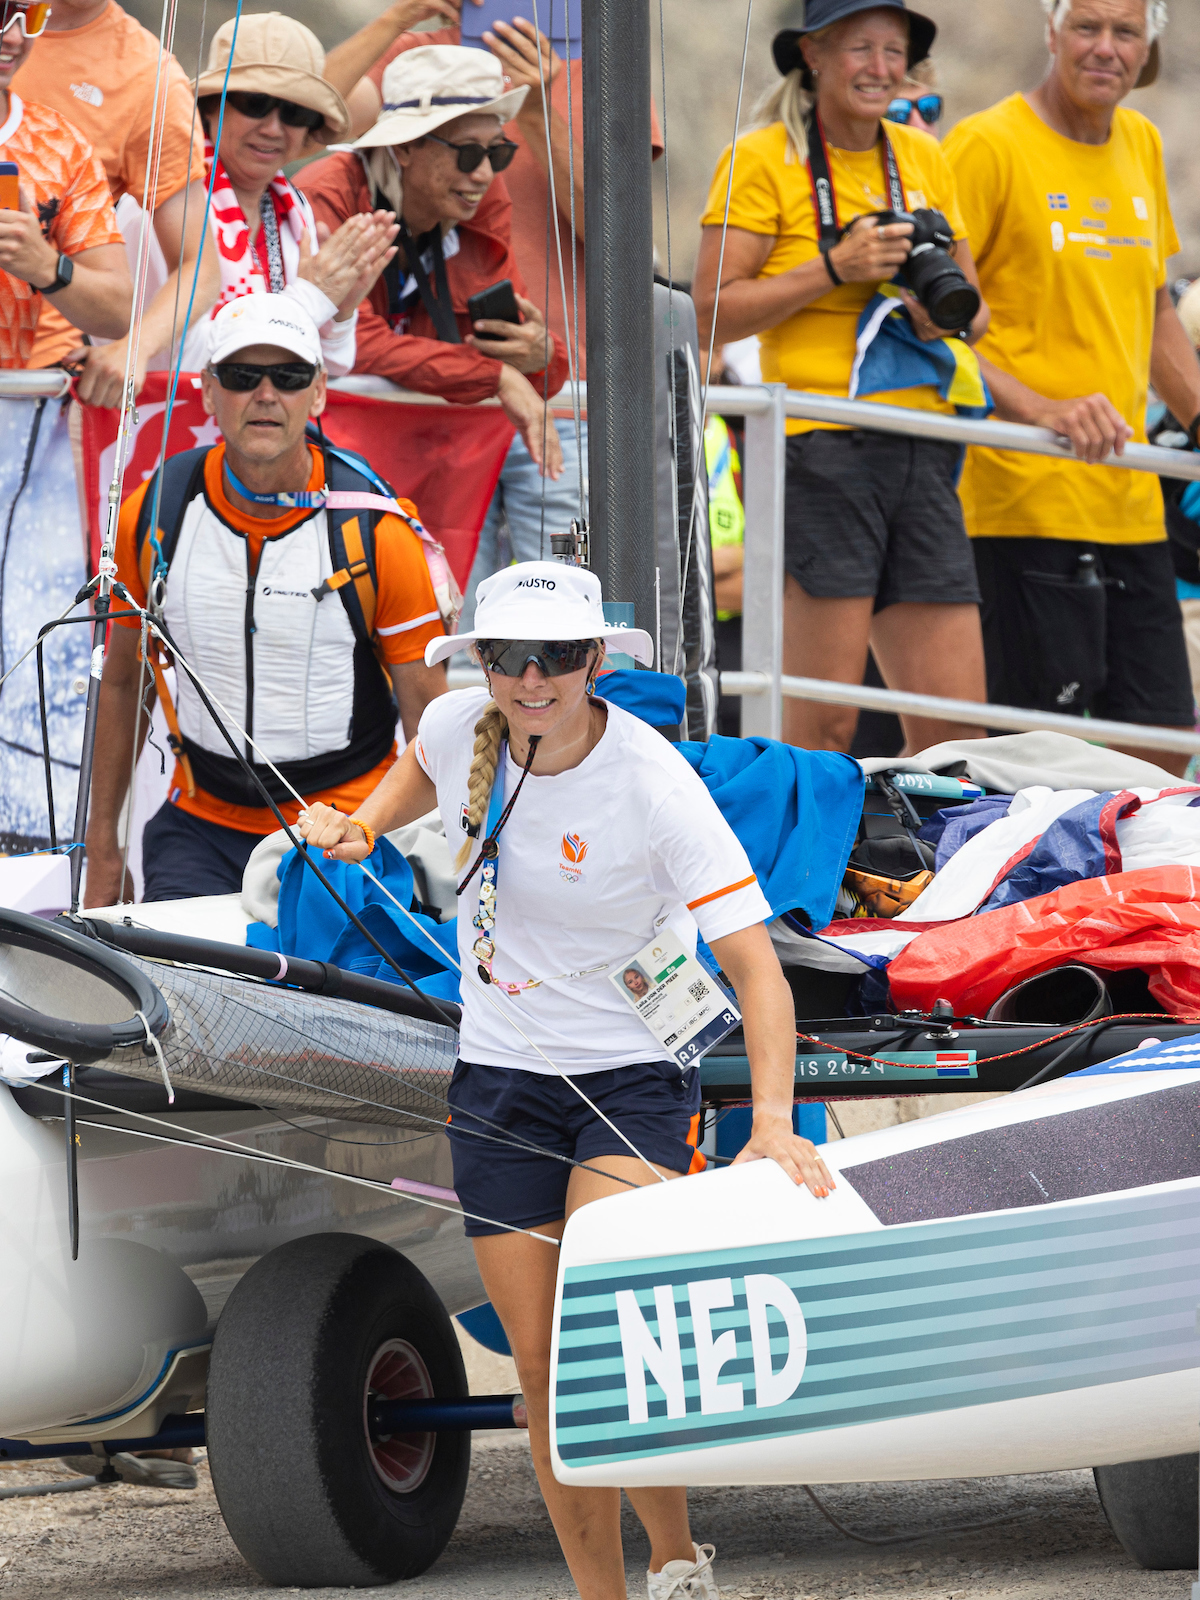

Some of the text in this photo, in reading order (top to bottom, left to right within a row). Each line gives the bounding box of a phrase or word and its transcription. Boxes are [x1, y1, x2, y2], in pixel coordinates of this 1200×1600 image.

[897, 773, 933, 789] 2024
[559, 862, 582, 875] TeamNL
[635, 998, 648, 1009] Laila
[656, 983, 666, 992] DER
[665, 973, 679, 985] MEER
[699, 1007, 710, 1017] MPC
[723, 1013, 734, 1024] R
[689, 1018, 697, 1026] IBC
[688, 1043, 699, 1056] 2
[615, 1274, 807, 1424] NED
